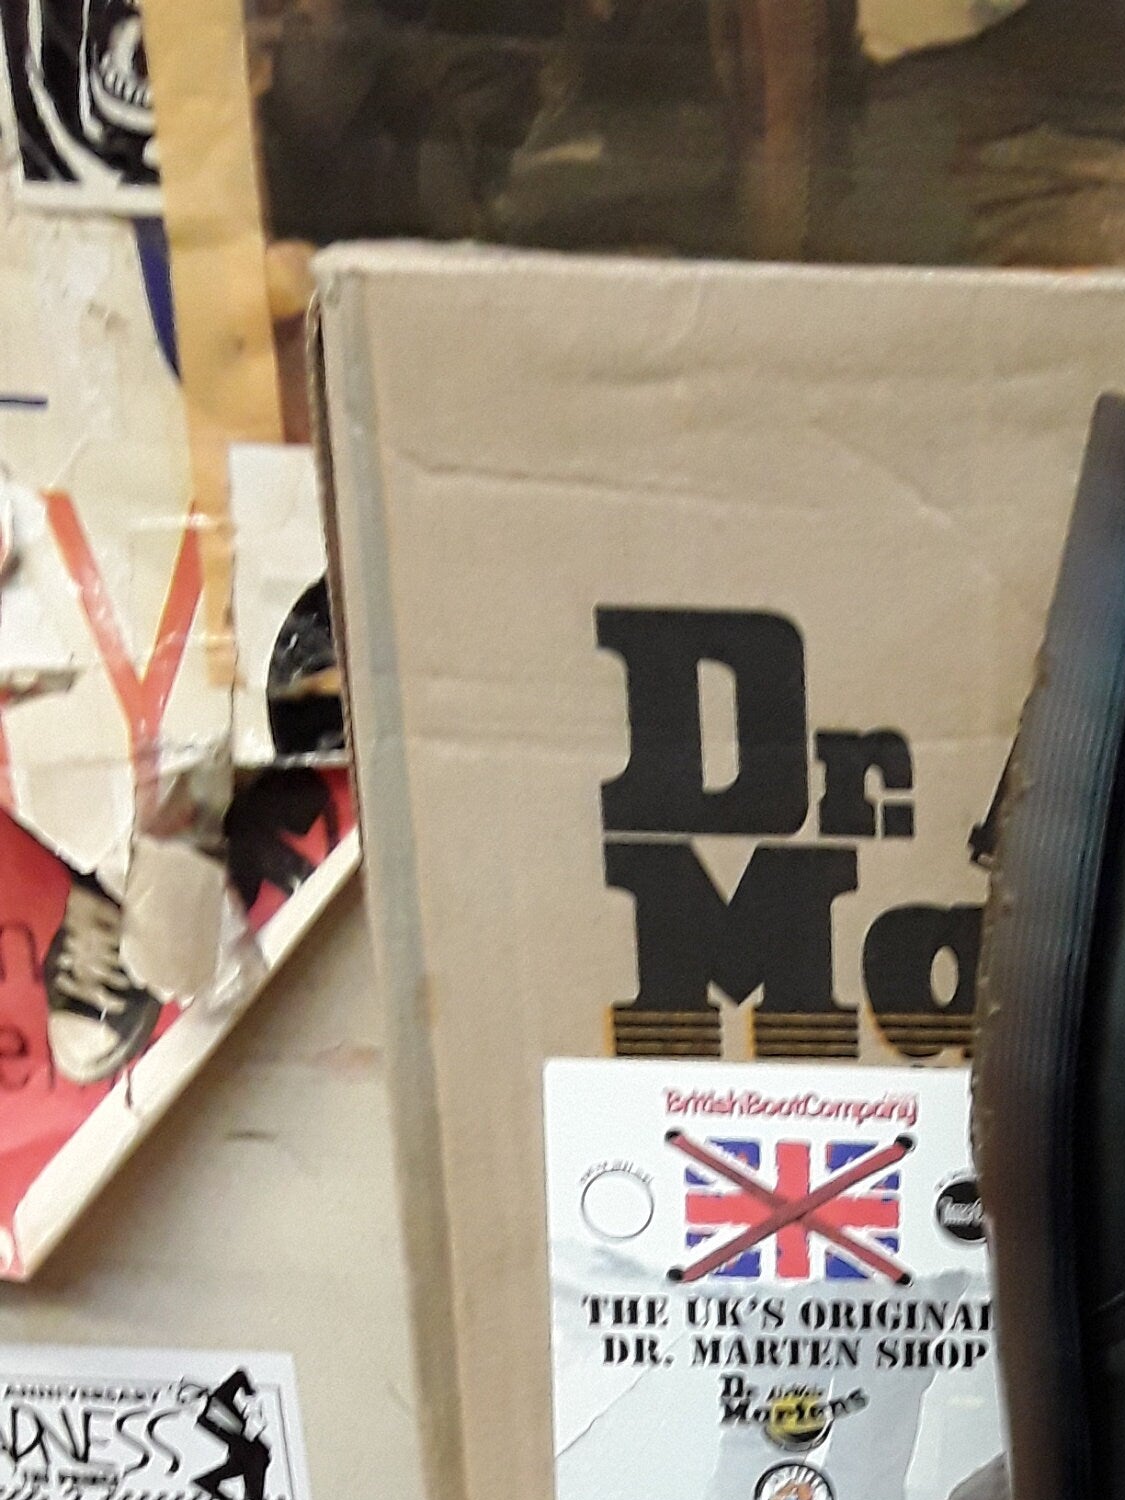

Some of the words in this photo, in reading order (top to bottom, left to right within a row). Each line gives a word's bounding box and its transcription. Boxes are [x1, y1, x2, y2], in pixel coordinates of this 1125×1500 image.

[582, 1295, 668, 1327] THE
[602, 1337, 674, 1368] DR.
[691, 1338, 860, 1369] MARTEN
[877, 1338, 988, 1369] SHOP
